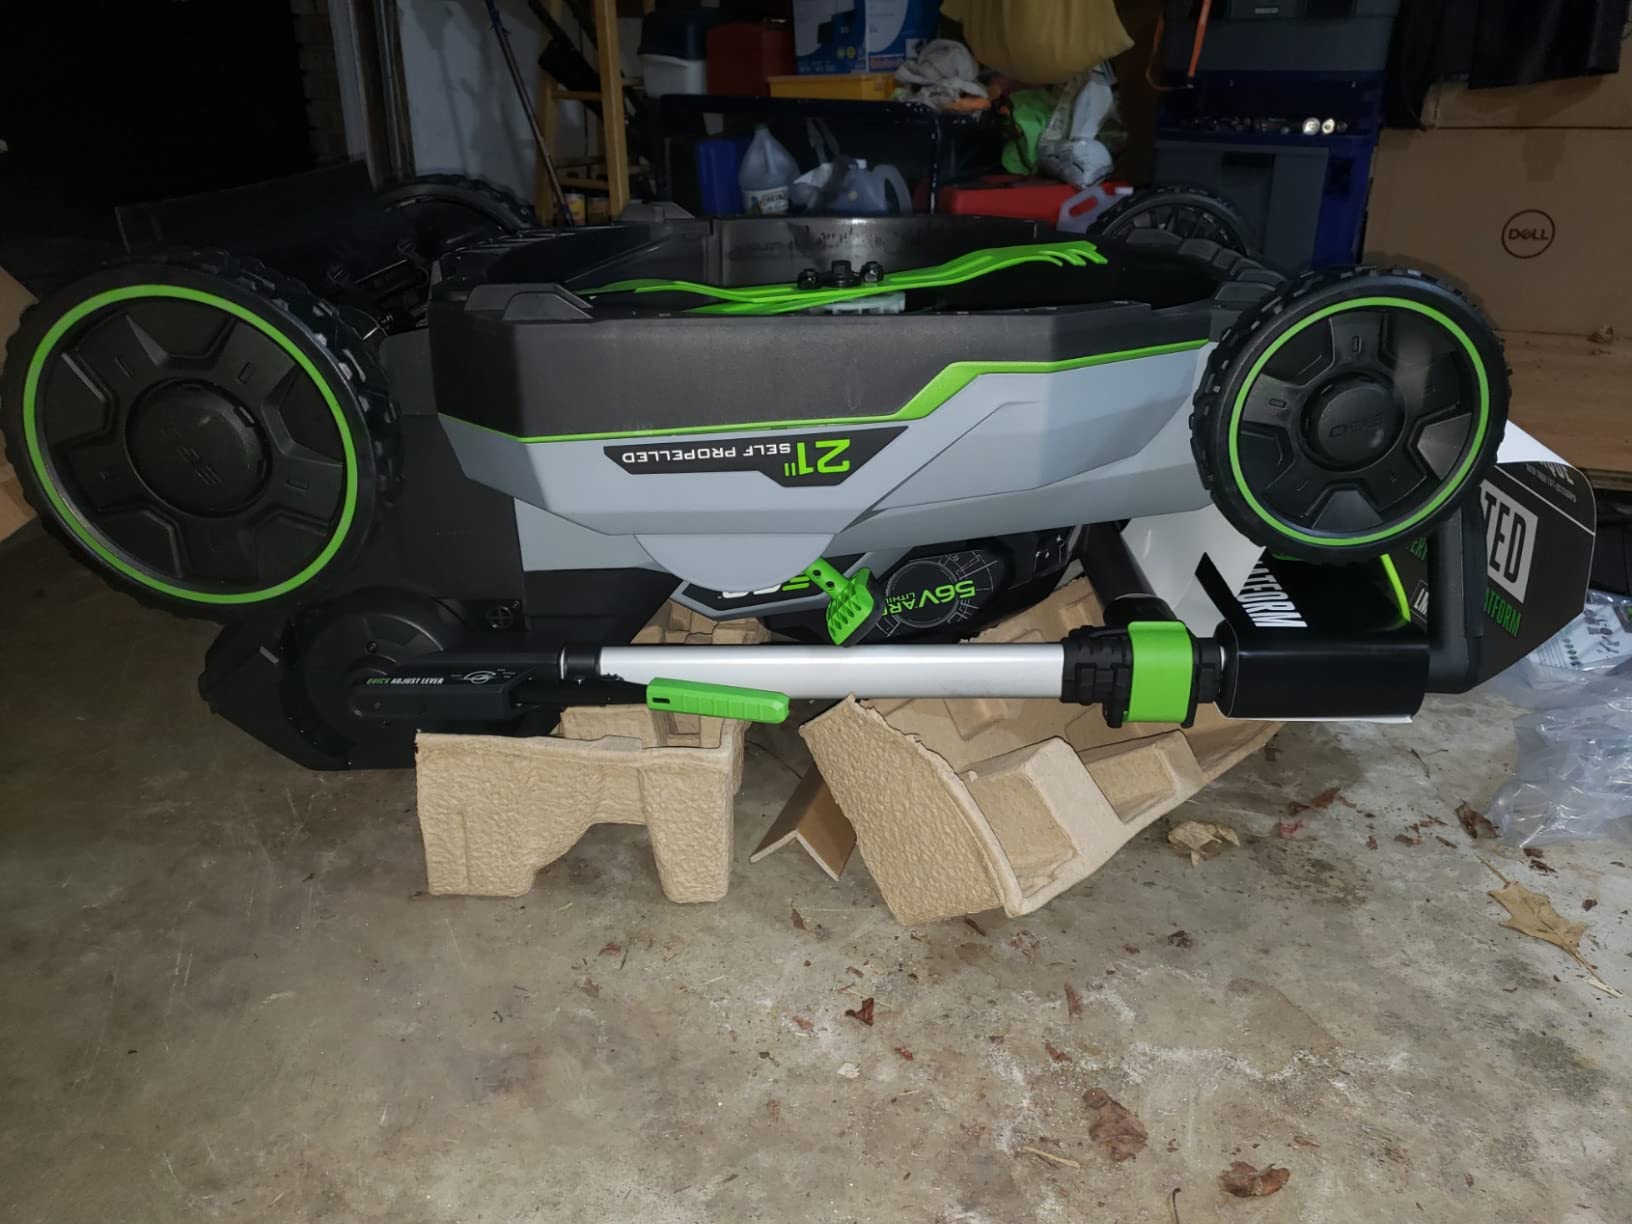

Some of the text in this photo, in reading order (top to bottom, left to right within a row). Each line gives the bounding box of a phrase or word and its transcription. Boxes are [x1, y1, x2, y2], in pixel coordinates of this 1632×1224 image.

[1508, 227, 1549, 241] DELL
[621, 443, 792, 464] SELF PROPELLED
[1484, 491, 1527, 583] TED
[919, 580, 976, 608] 56V
[390, 677, 420, 685] ADJUST
[420, 677, 444, 685] LEVER
